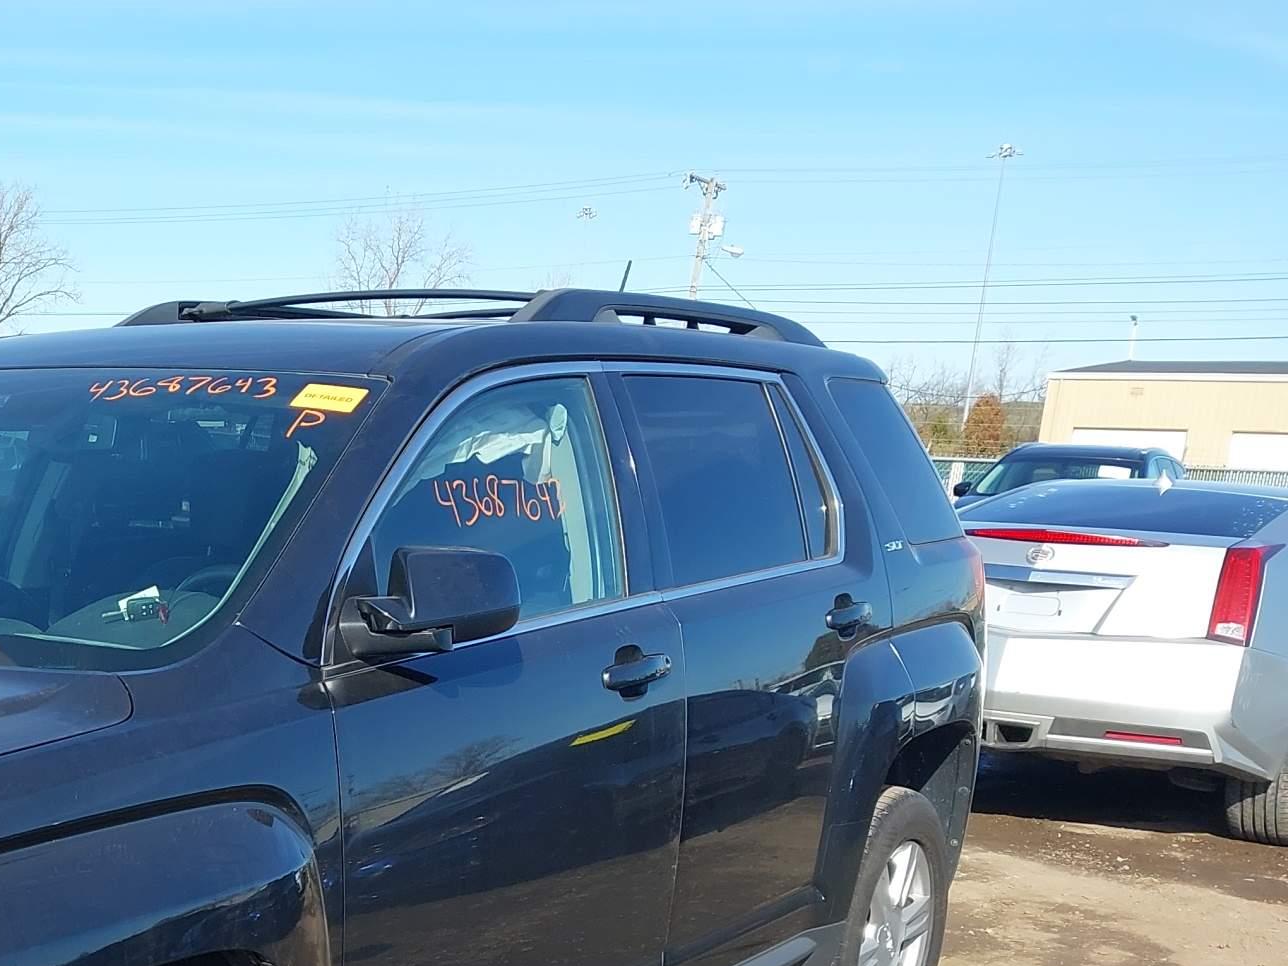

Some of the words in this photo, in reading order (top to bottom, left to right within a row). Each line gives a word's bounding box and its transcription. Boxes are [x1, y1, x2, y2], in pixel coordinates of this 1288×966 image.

[89, 375, 278, 403] 43687643
[285, 408, 327, 439] P
[434, 474, 567, 529] 43687643
